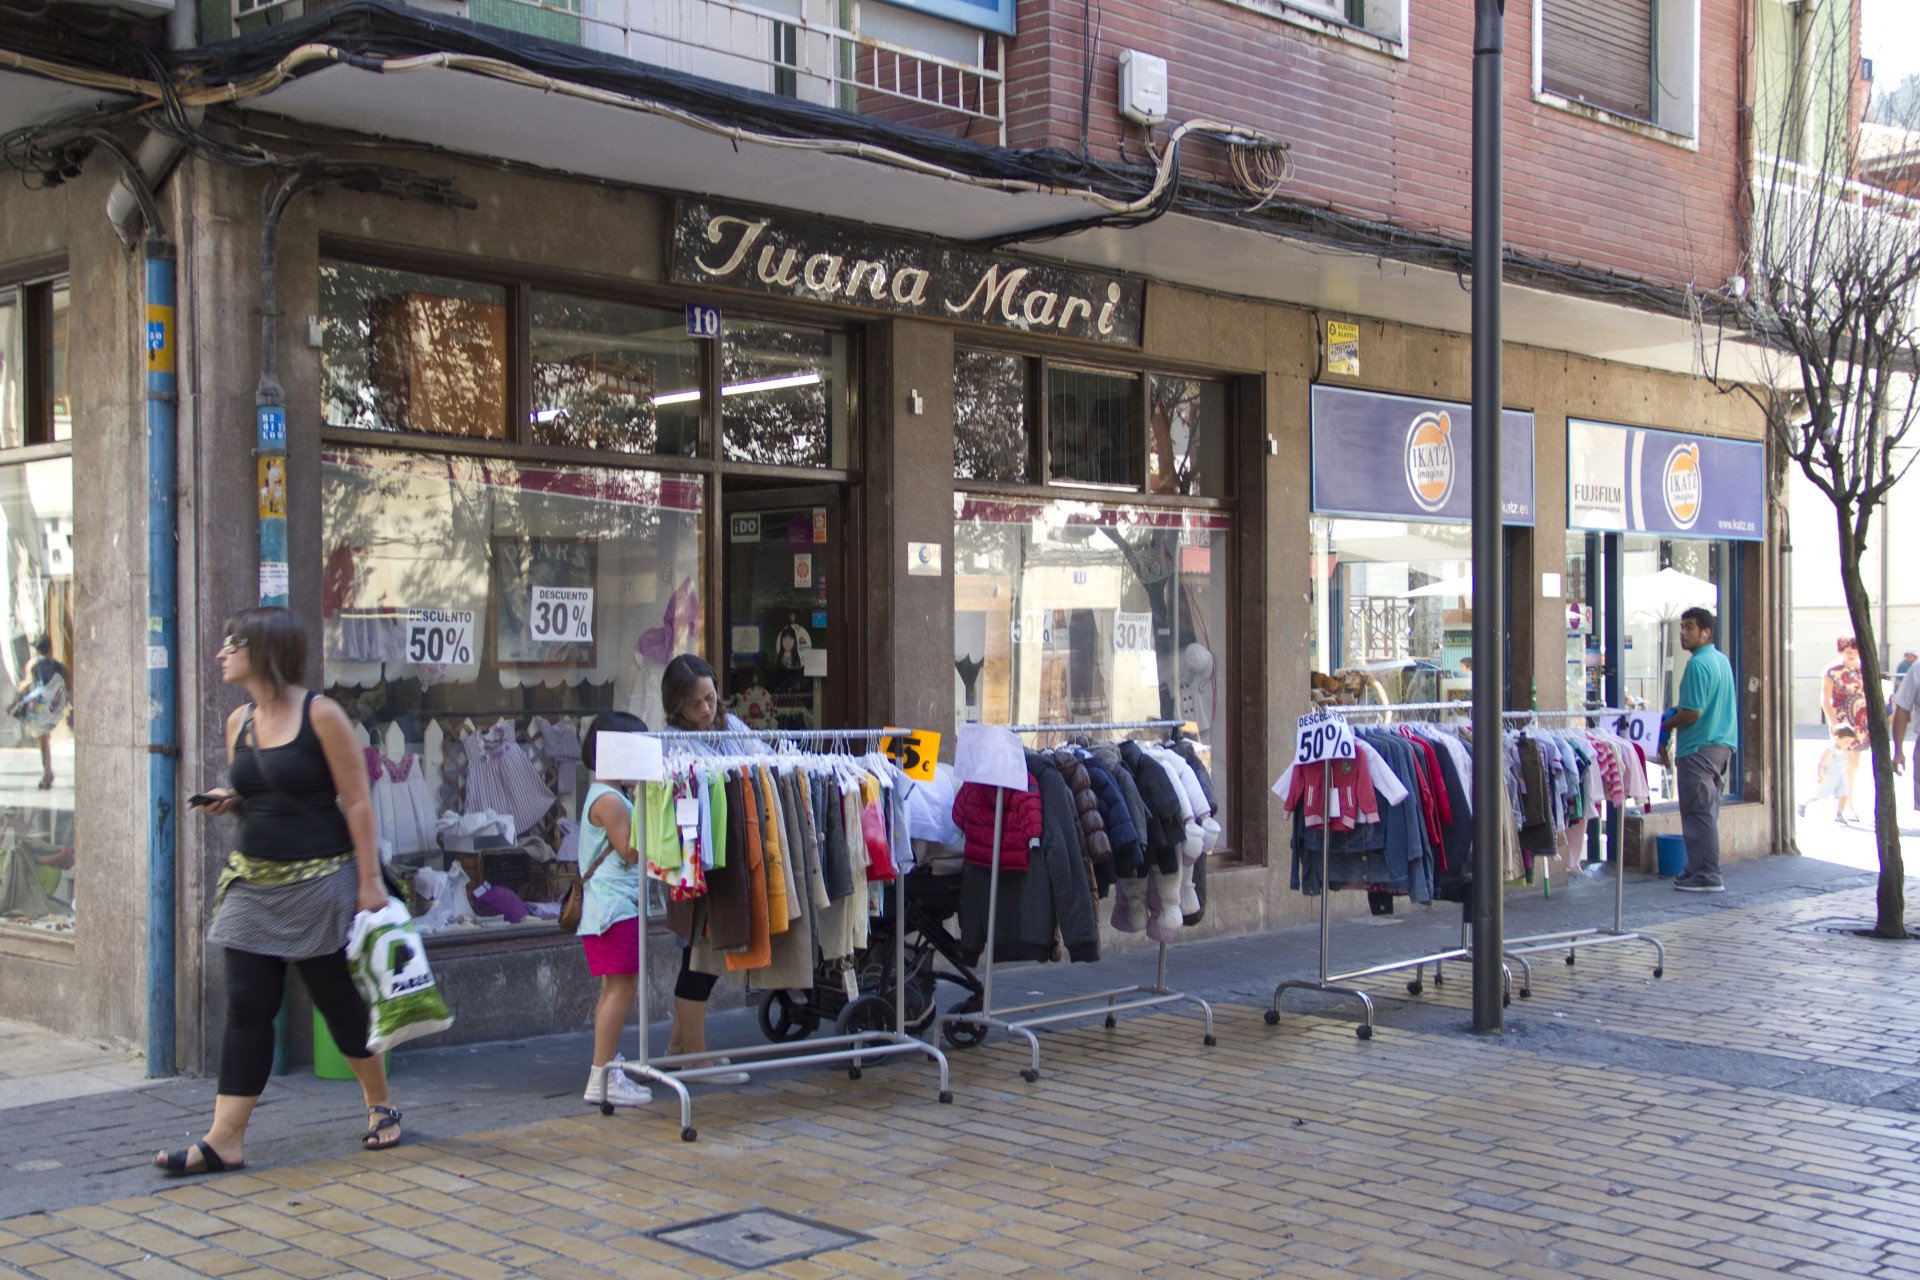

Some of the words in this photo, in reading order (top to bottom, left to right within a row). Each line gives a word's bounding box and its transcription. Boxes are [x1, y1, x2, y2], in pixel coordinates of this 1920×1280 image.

[694, 215, 929, 306] Juana
[945, 264, 1121, 334] Mari
[694, 307, 718, 335] 10
[1413, 446, 1448, 468] IKATZ
[1670, 472, 1697, 493] IKATZ
[1574, 484, 1621, 504] FUJIFILM
[1502, 501, 1529, 515] katz.es
[1718, 519, 1755, 532] www.ikatz.es
[503, 543, 587, 571] PARS
[539, 589, 588, 601] DESCUENTO
[408, 610, 472, 623] DESCUENTO
[534, 602, 587, 637] 30%
[1119, 613, 1149, 623] DESCUENTO
[410, 627, 470, 663] 50%
[1116, 623, 1149, 650] 30%
[1299, 724, 1352, 763] 50%
